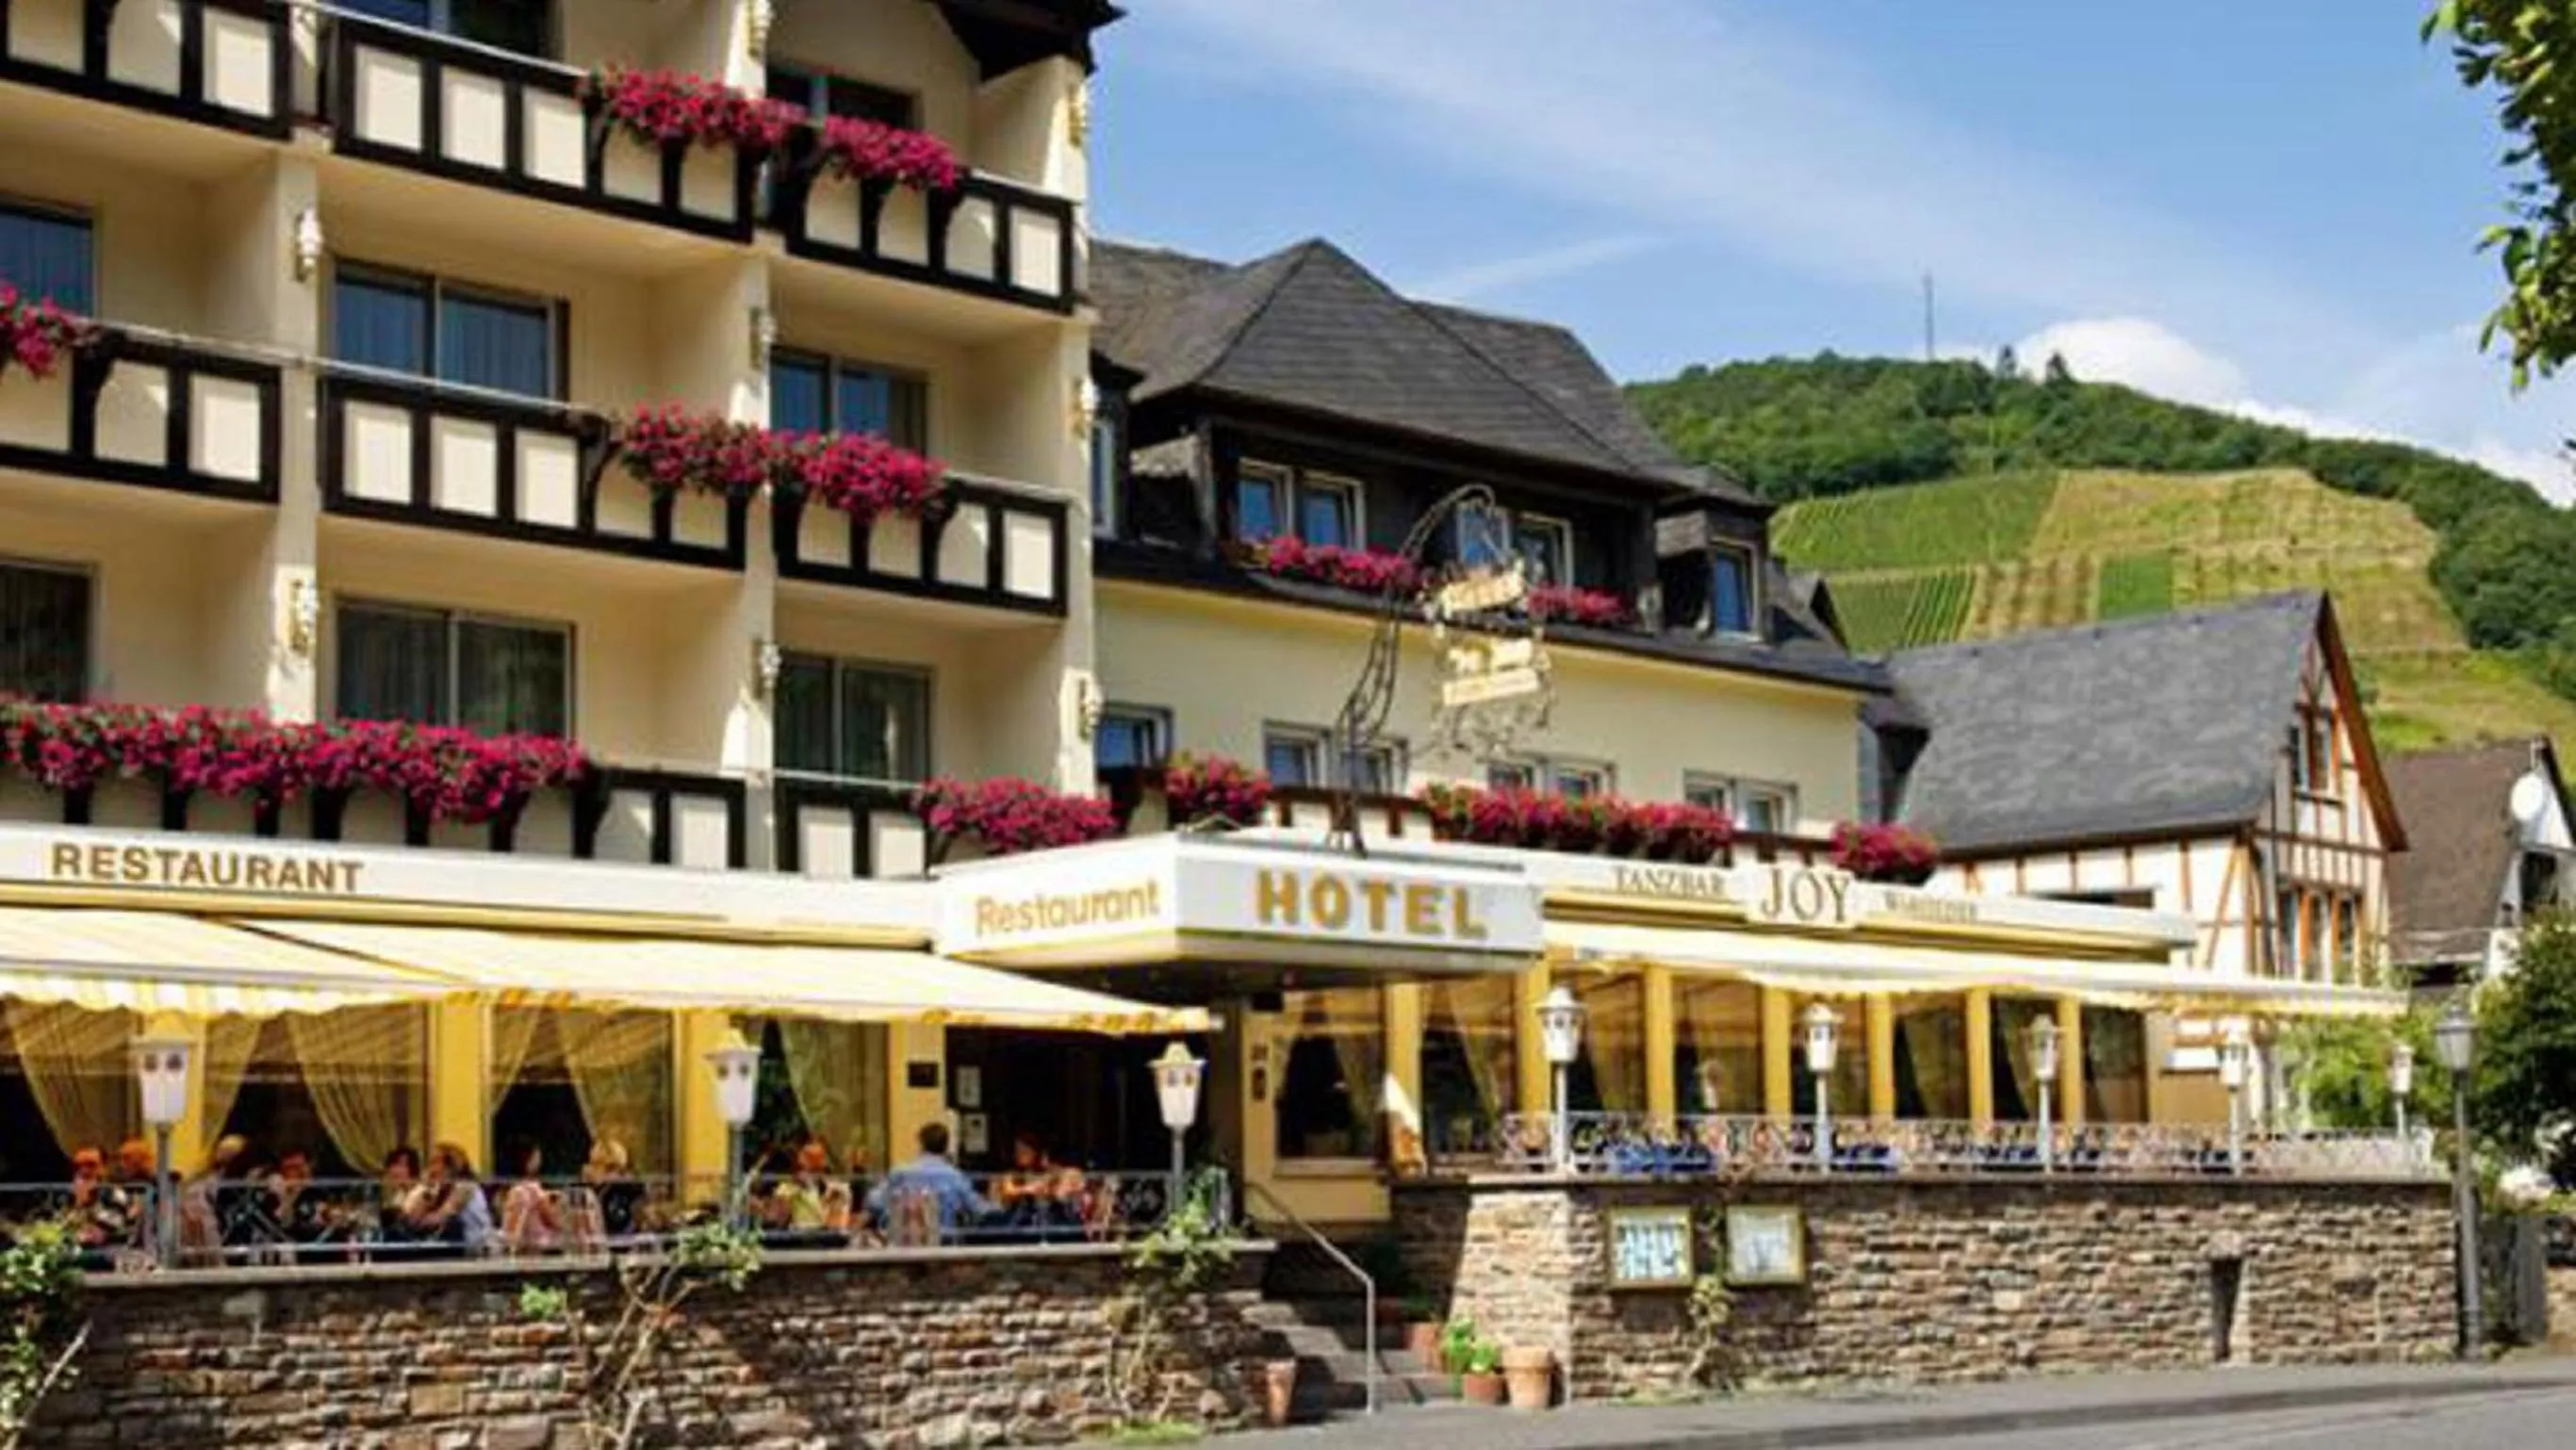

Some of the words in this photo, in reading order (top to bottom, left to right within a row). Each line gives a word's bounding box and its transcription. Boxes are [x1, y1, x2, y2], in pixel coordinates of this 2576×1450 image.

[52, 842, 364, 893] RESTAURANT
[1760, 867, 1851, 922] JOY
[975, 879, 1160, 935] Restaurant
[1255, 869, 1488, 939] HOTEL
